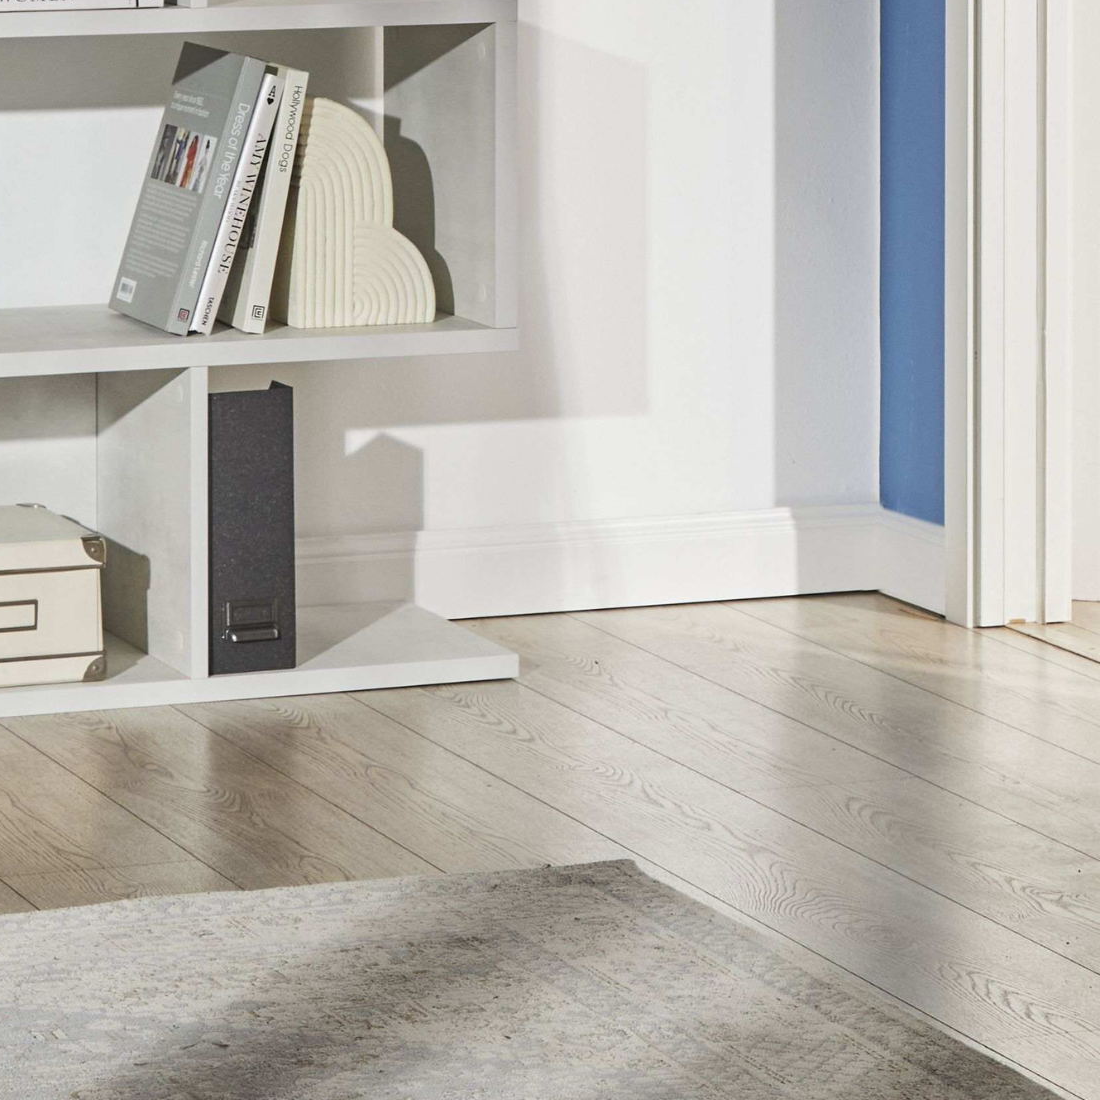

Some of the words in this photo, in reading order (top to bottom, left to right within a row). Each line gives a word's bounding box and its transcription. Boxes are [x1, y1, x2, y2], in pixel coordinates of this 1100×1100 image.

[231, 103, 250, 136] Dress
[285, 85, 303, 140] Hollywood
[228, 137, 238, 151] of
[250, 133, 266, 170] AMY
[278, 143, 293, 173] Dogs
[221, 152, 236, 171] the
[214, 174, 229, 199] Year
[218, 174, 256, 274] WINEHOUSE
[201, 296, 215, 326] TASCHEN
